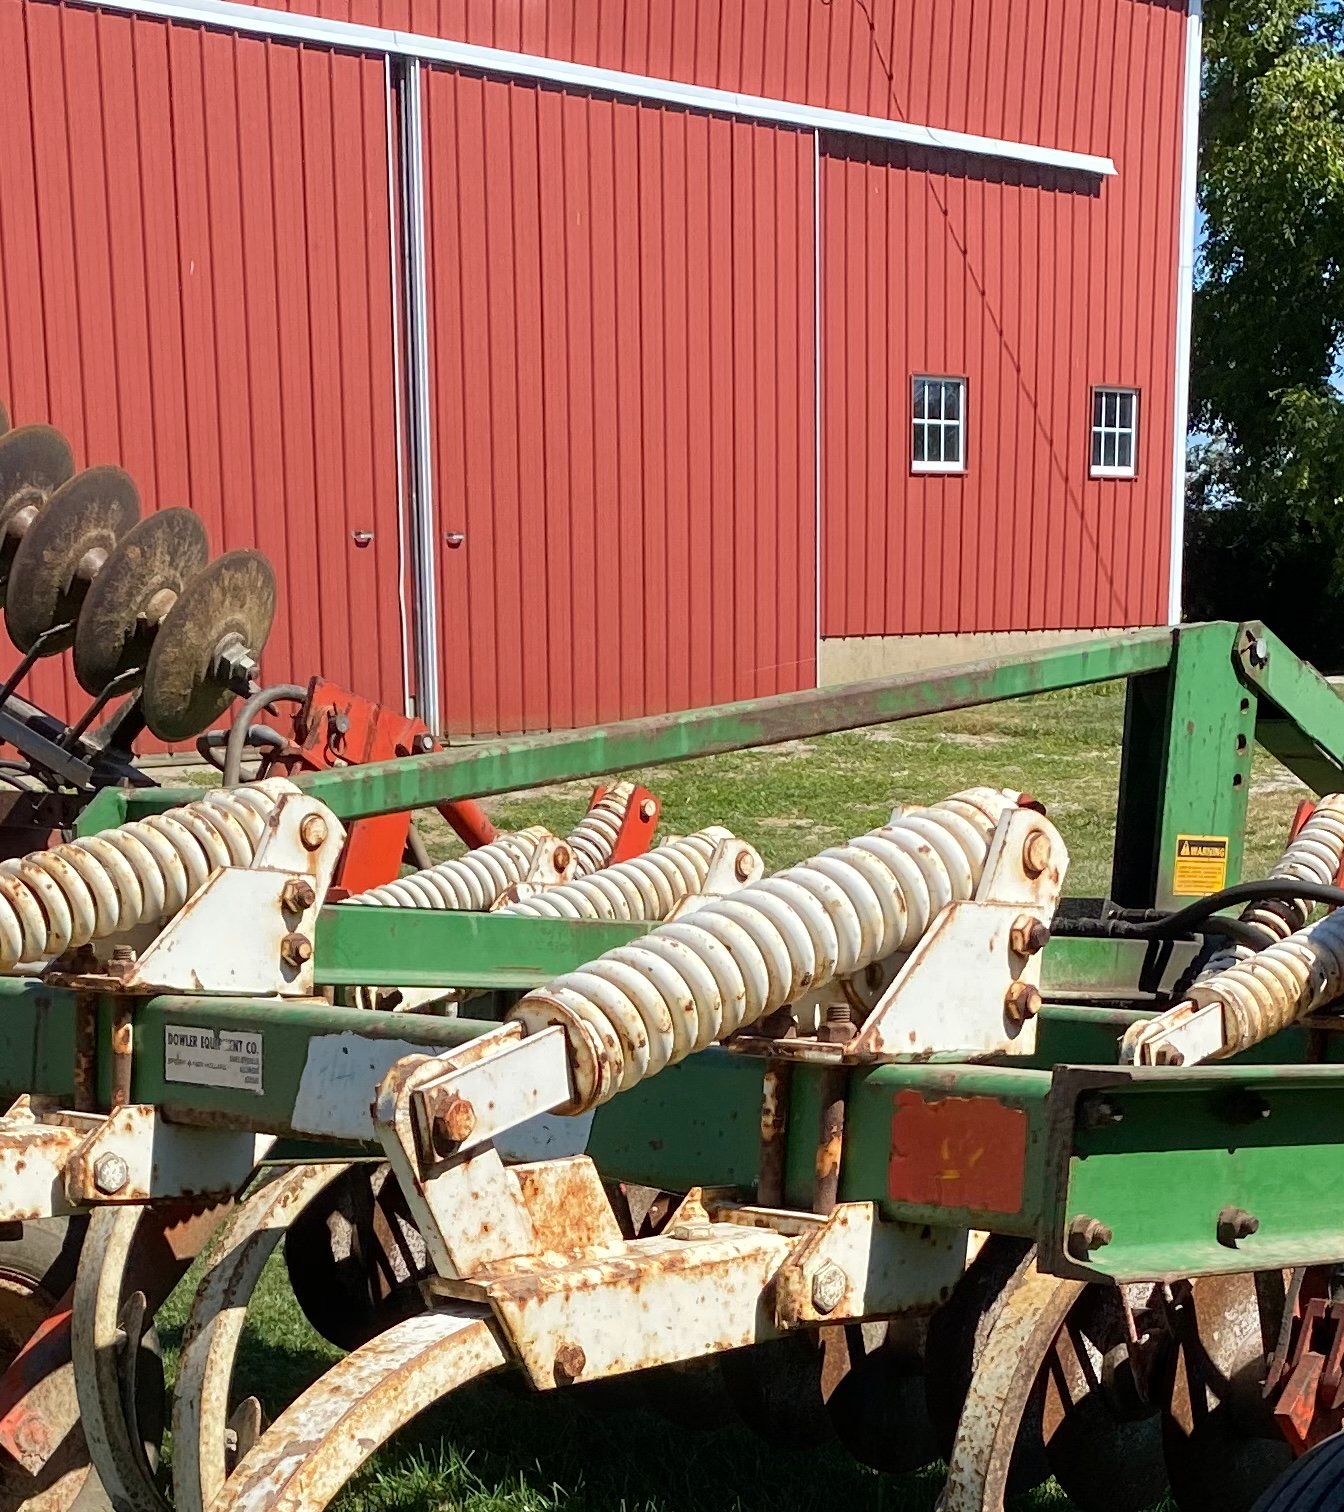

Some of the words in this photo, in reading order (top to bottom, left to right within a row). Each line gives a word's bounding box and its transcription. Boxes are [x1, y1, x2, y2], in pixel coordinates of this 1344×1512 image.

[1190, 846, 1225, 857] WARNING
[167, 1032, 198, 1048] DOWLER
[200, 1035, 243, 1053] EQUIPENT
